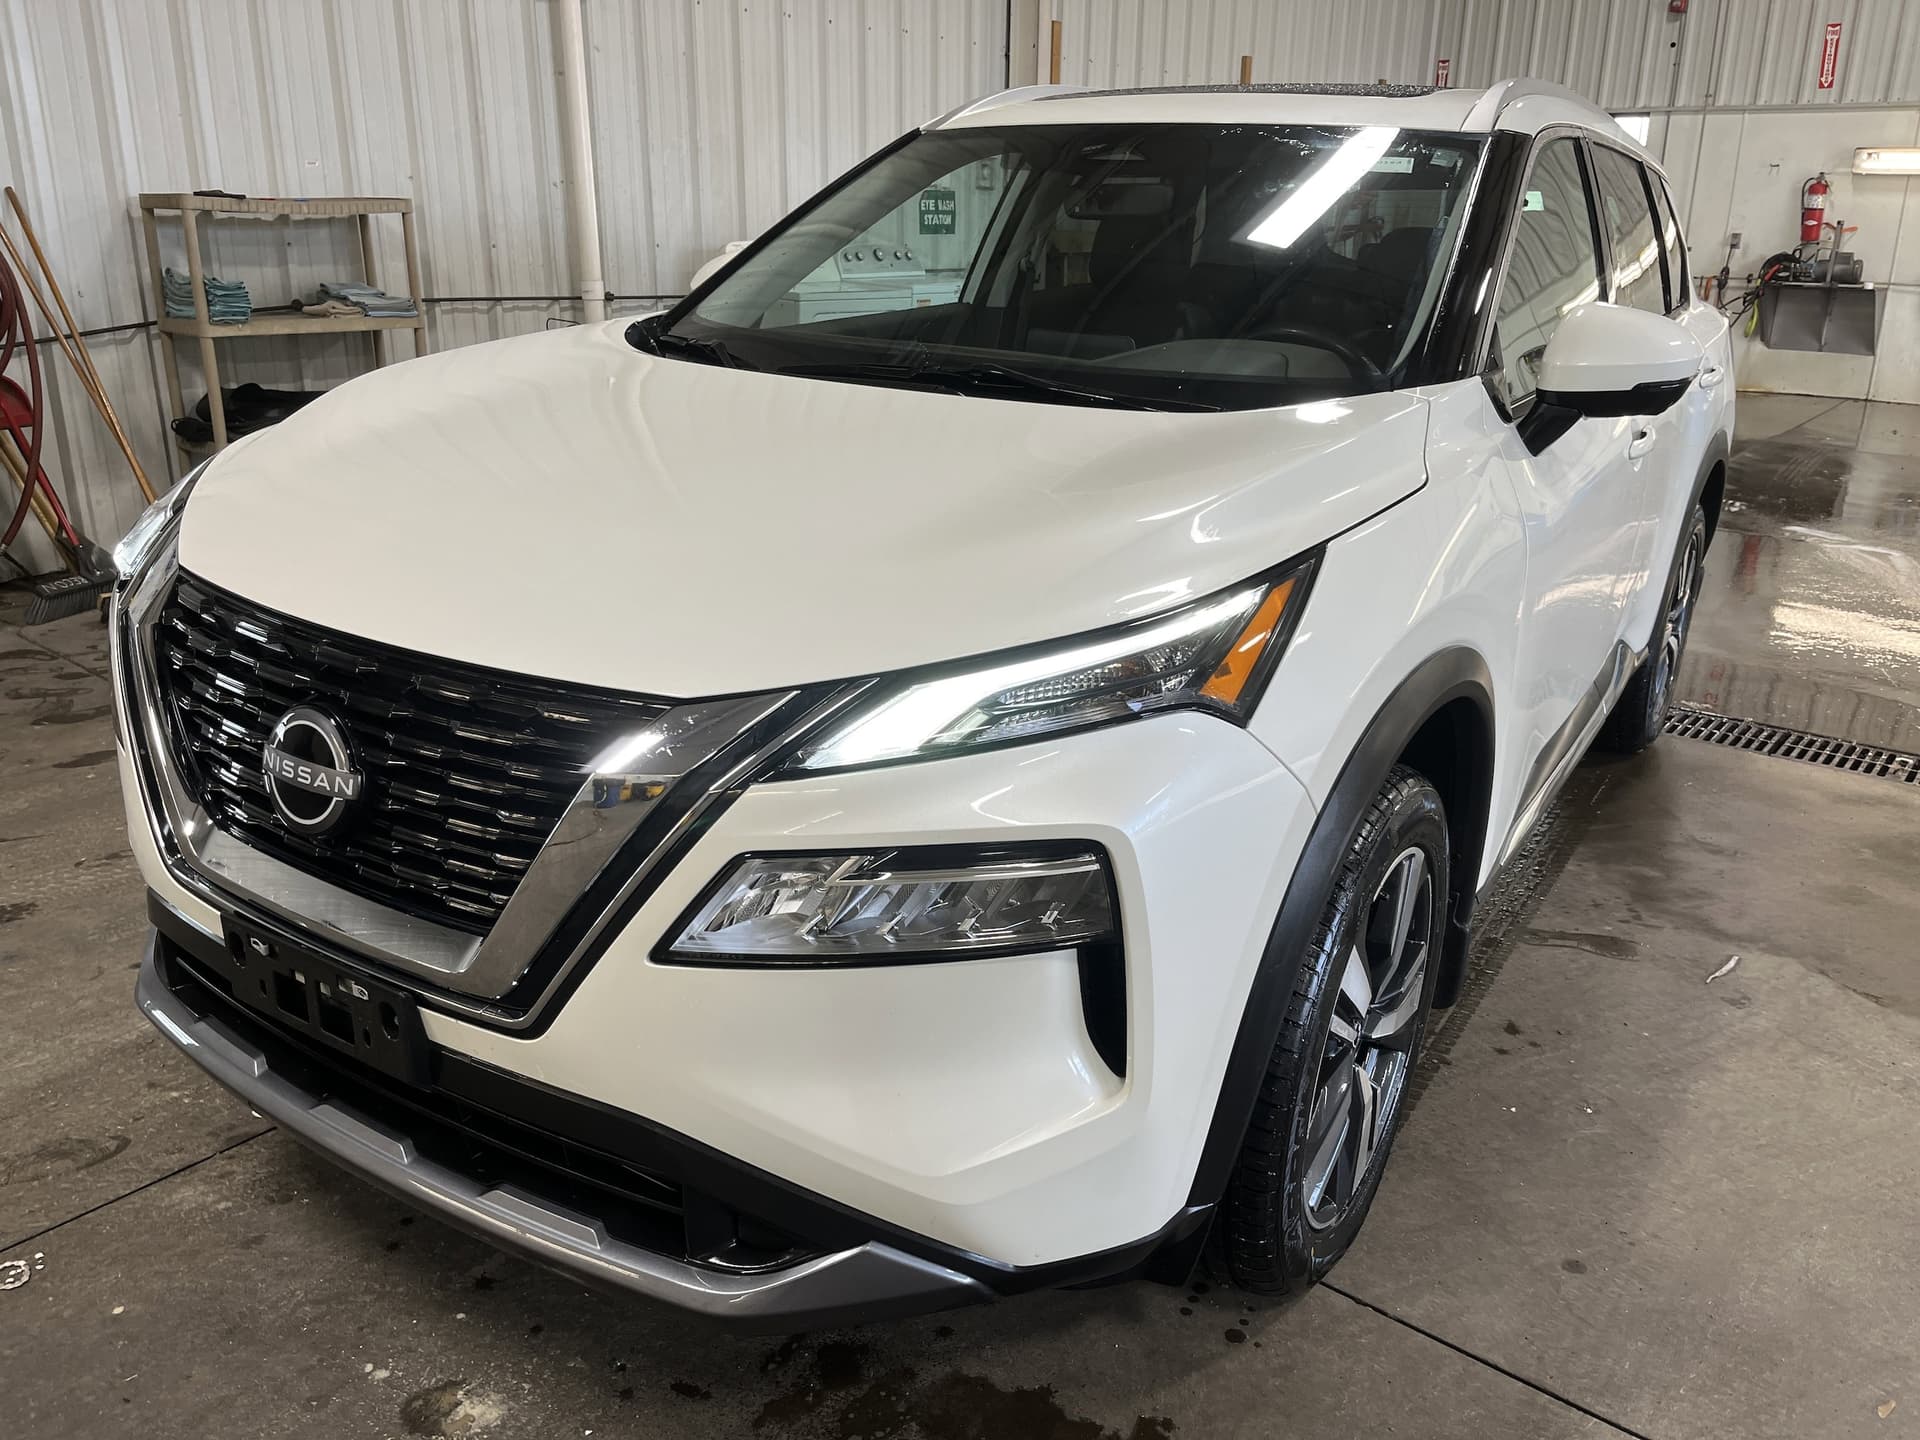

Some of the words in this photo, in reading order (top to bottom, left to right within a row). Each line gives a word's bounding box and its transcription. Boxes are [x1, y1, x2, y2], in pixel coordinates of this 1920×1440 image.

[921, 200, 936, 211] EYE
[938, 200, 954, 211] WASH
[924, 214, 952, 225] STATION
[263, 748, 353, 796] NISSAN
